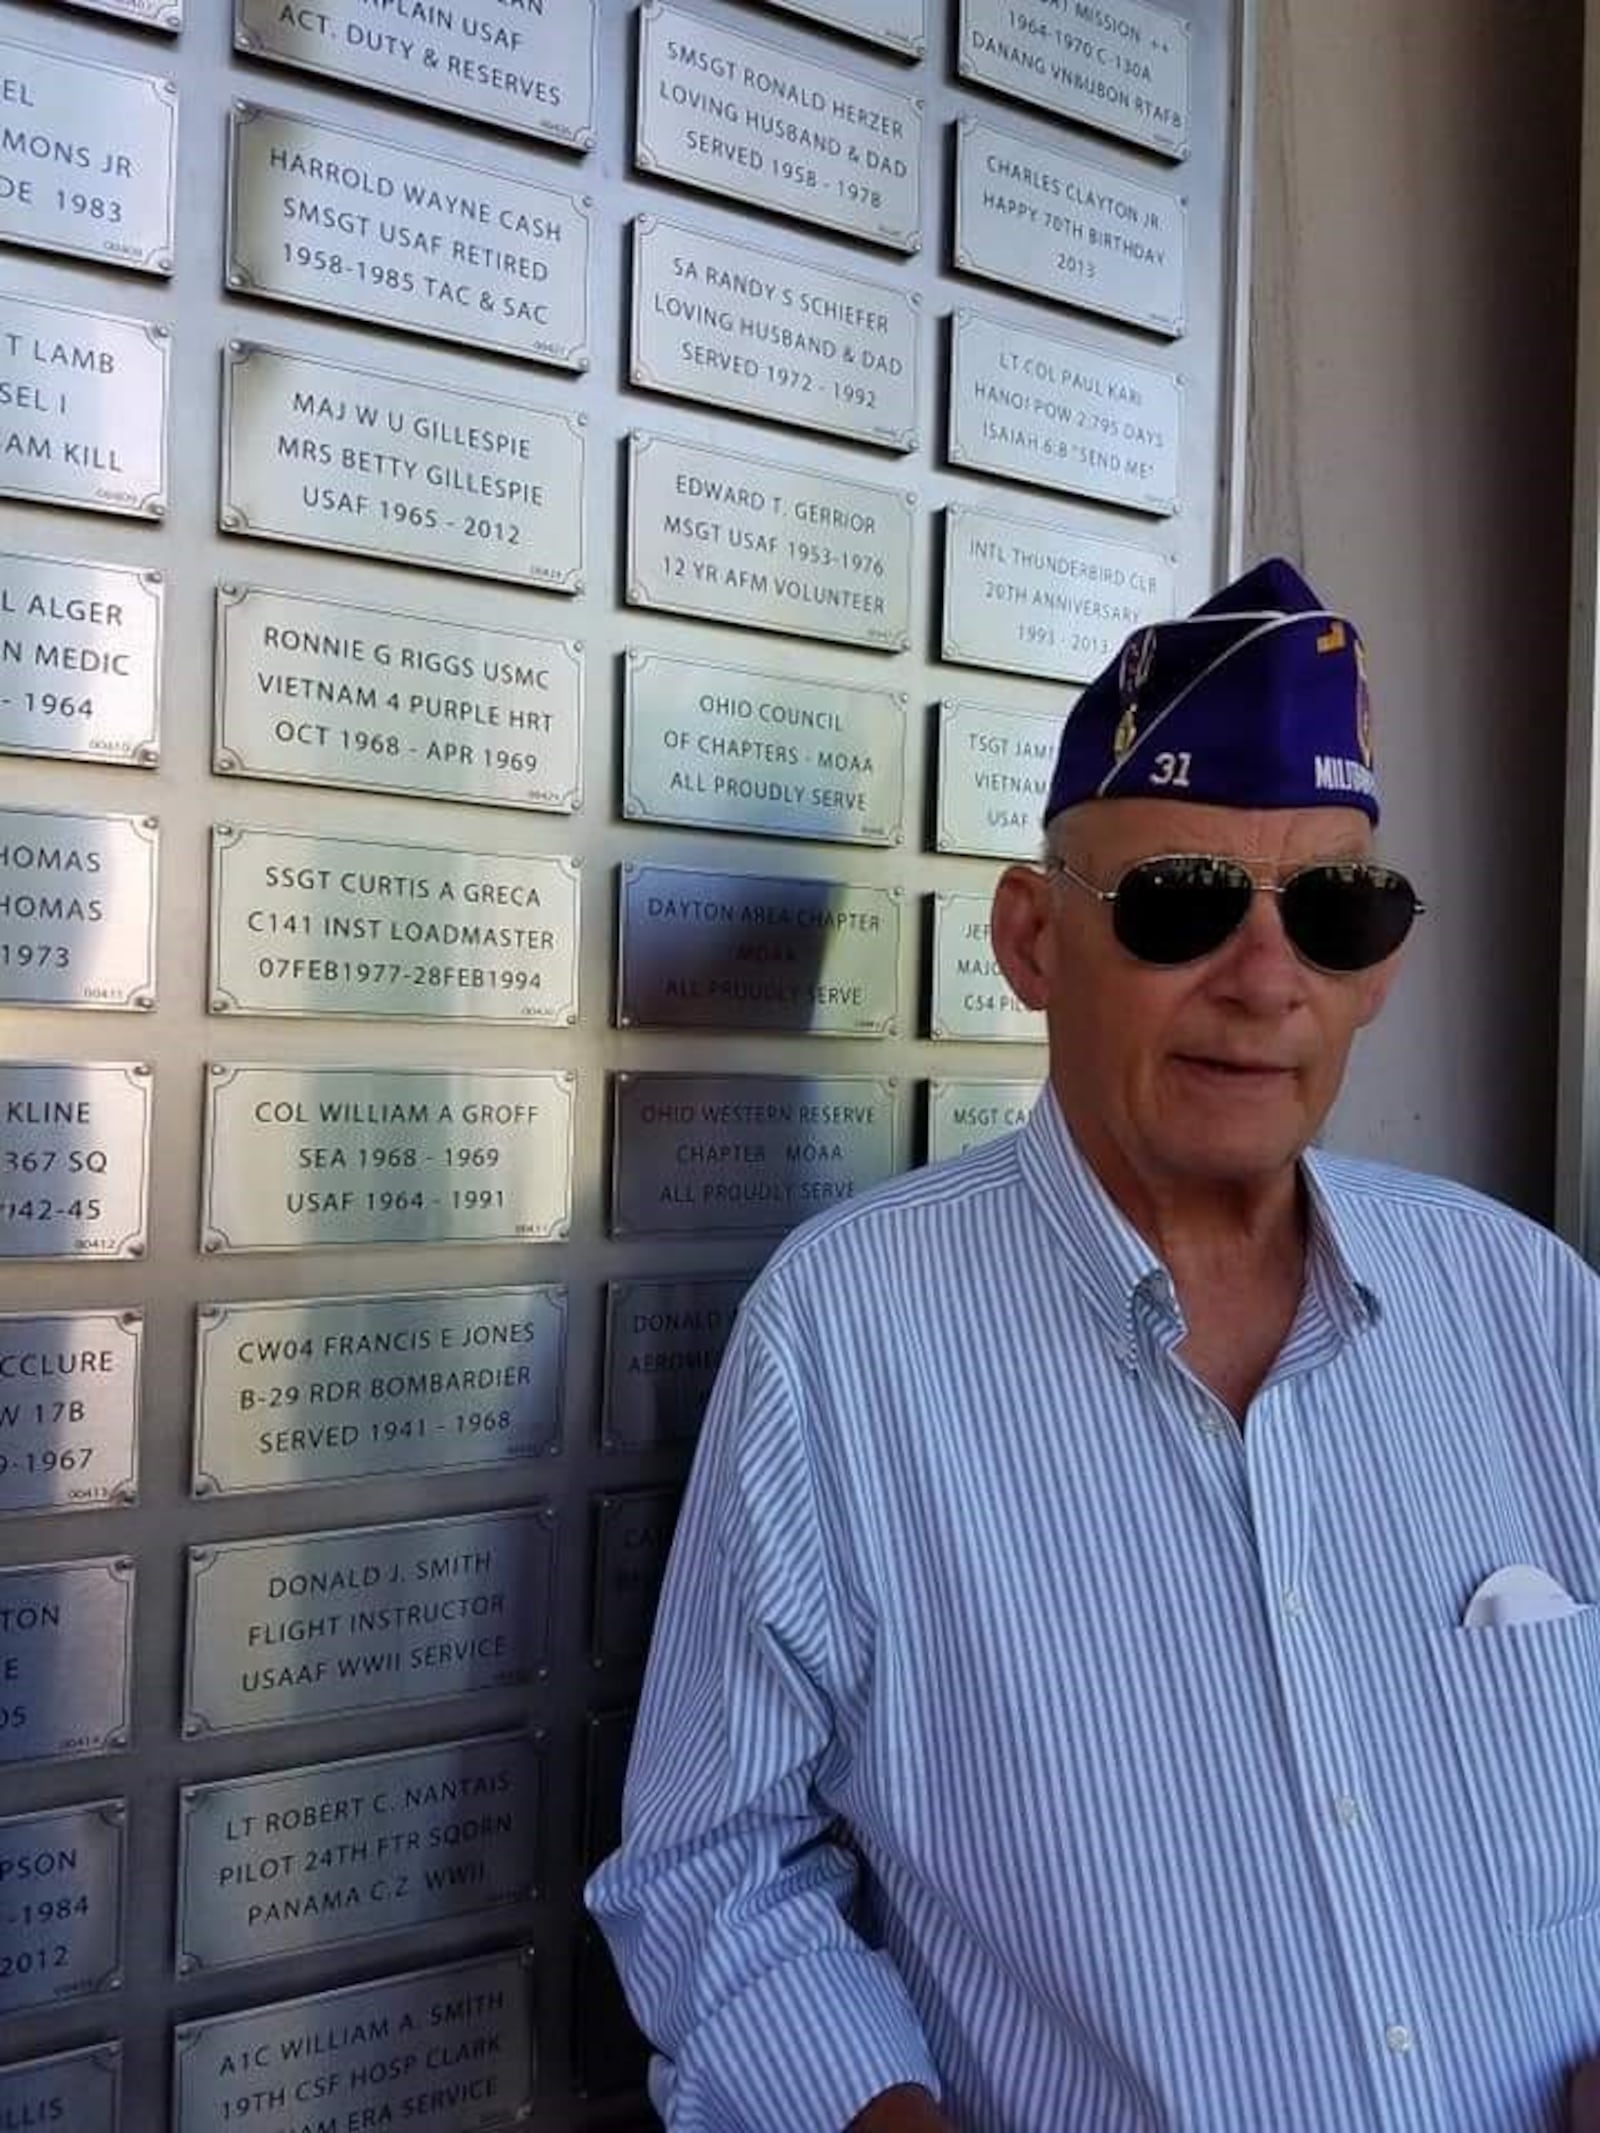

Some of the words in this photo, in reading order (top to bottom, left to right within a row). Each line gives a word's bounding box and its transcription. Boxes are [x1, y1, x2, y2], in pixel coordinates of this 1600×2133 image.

[462, 17, 523, 51] USAF
[1075, 4, 1140, 43] MISSION
[279, 6, 336, 41] ACT.
[347, 25, 414, 64] DUTY
[449, 54, 561, 107] RESERVES
[972, 31, 1045, 75] DANANG
[668, 40, 735, 81] SMSGT
[744, 66, 825, 112] RONALD
[833, 97, 903, 139] HERZER
[660, 81, 738, 123] LOVING
[746, 109, 840, 157] HUSBAND
[866, 149, 907, 179] DAD
[687, 130, 763, 171] SERVED
[773, 158, 816, 188] 1958
[839, 179, 882, 208] 1978
[988, 155, 1060, 196] CHARLES
[1067, 183, 1138, 223] CLAYTON
[58, 190, 122, 223] 1983
[270, 147, 394, 198] HARROLD
[403, 182, 490, 224] WAYNE
[501, 208, 562, 242] CASH
[284, 198, 370, 237] SMSGT
[380, 221, 442, 255] USAF
[453, 239, 548, 281] RETIRED
[984, 191, 1037, 221] HAPPY
[1089, 228, 1164, 266] BIRTHDAY
[285, 244, 414, 293] 1958-1985
[425, 276, 473, 307] TAC
[504, 294, 549, 325] SAC
[1057, 253, 1096, 278] 2013
[674, 257, 697, 281] SA
[706, 266, 775, 303] RANDY
[801, 292, 888, 334] SCHIEFER
[35, 339, 114, 374] LAMB
[656, 294, 733, 332] LOVING
[741, 316, 836, 359] HUSBAND
[862, 347, 903, 377] DAD
[682, 342, 758, 378] SERVED
[768, 363, 812, 392] 1972
[1062, 369, 1102, 397] PAUL
[294, 393, 345, 421] MAJ
[414, 417, 530, 459] GILLESPIE
[65, 443, 123, 473] KILL
[278, 436, 332, 466] MRS
[343, 449, 416, 482] BETTY
[427, 465, 543, 506] GILLESPIE
[303, 487, 368, 518] USAF
[381, 501, 436, 530] 1965
[464, 516, 520, 545] 2012
[677, 475, 765, 511] EDWARD
[795, 500, 875, 534] GERRIOR
[664, 516, 720, 543] MSGT
[729, 528, 777, 555] USAF
[664, 556, 685, 577] 12
[693, 562, 717, 583] YR
[725, 567, 767, 592] AFM
[775, 577, 884, 614] VOLUNTEER
[1013, 547, 1124, 585] THUNDERBIRD
[28, 594, 123, 627] ALGER
[985, 582, 1027, 601] 20TH
[1033, 590, 1138, 623] ANNIVERSARY
[36, 644, 130, 675] MEDIC
[264, 627, 363, 661] RONNIE
[401, 648, 474, 678] RIGGS
[484, 660, 549, 690] USMC
[25, 692, 93, 718] 1964
[259, 674, 376, 709] VIETNAM
[410, 694, 499, 726] PURPLE
[510, 708, 553, 733] HRT
[700, 695, 751, 719] OHIO
[759, 703, 843, 731] COUNCIL
[276, 722, 329, 748] OCT
[343, 730, 400, 756] 1968
[427, 740, 472, 765] APR
[485, 747, 537, 773] 1969
[664, 730, 689, 750] OF
[698, 734, 798, 763] CHAPTERS
[818, 749, 872, 772] MOAA
[969, 733, 1008, 755] TSGT
[1150, 752, 1192, 787] 31
[671, 772, 705, 792] ALL
[715, 777, 808, 804] PROUDLY
[813, 788, 866, 811] SERVE
[987, 808, 1028, 827] USAF
[266, 867, 330, 891] SSGT
[342, 873, 429, 899] CURTIS
[464, 882, 540, 907] GRECA
[249, 911, 311, 935] C141
[324, 916, 382, 939] INST
[391, 921, 554, 949] LOADMASTER
[649, 898, 734, 922] DAYTON
[7, 1102, 90, 1123] KLINE
[255, 1102, 308, 1123] COL
[320, 1103, 428, 1124] WILLIAM
[463, 1105, 538, 1124] GROFF
[702, 1105, 791, 1124] WESTERN
[801, 1105, 874, 1124] RESERVE
[954, 1108, 998, 1126] MSGT
[69, 1151, 107, 1174] SQ
[299, 1148, 346, 1168] SEA
[359, 1148, 417, 1168] 1968
[446, 1148, 499, 1168] 1969
[287, 1193, 354, 1213] USAF
[368, 1192, 423, 1211] 1964
[453, 1191, 503, 1210] 1991
[660, 1185, 694, 1202] ALL
[325, 1329, 430, 1358] FRANCIS
[462, 1322, 534, 1348] JONES
[240, 1385, 299, 1410] B-29
[311, 1380, 360, 1404] RDR
[372, 1366, 531, 1399] BOMBARDIER
[37, 1402, 84, 1423] 17B
[260, 1424, 359, 1454] SERVED
[371, 1418, 425, 1443] 1941
[457, 1411, 510, 1434] 1968
[269, 1565, 380, 1598] DONALD
[417, 1552, 492, 1580] SMITH
[249, 1614, 342, 1647] FLIGHT
[351, 1594, 504, 1634] INSTRUCTOR
[242, 1660, 328, 1692] USAAF
[338, 1649, 400, 1679] WWII
[411, 1634, 505, 1669] SERVICE
[226, 1815, 256, 1841] LT
[265, 1796, 364, 1834] ROBERT
[406, 1771, 510, 1810] NANTAIS
[220, 1852, 297, 1886] PILOT
[305, 1839, 368, 1871] 24TH
[378, 1829, 421, 1858] FTR
[248, 1884, 360, 1926] PANAMA
[425, 1862, 484, 1895] WWII
[220, 2045, 270, 2078] A1C
[281, 2018, 389, 2063] WILLIAM
[430, 1992, 503, 2029] SMITH
[223, 2084, 286, 2120] 19TH
[296, 2072, 340, 2102] CSF
[351, 2054, 417, 2089] HOSP
[426, 2035, 500, 2071] CLARK
[349, 2100, 392, 2133] ERA
[403, 2076, 496, 2120] SERVICE
